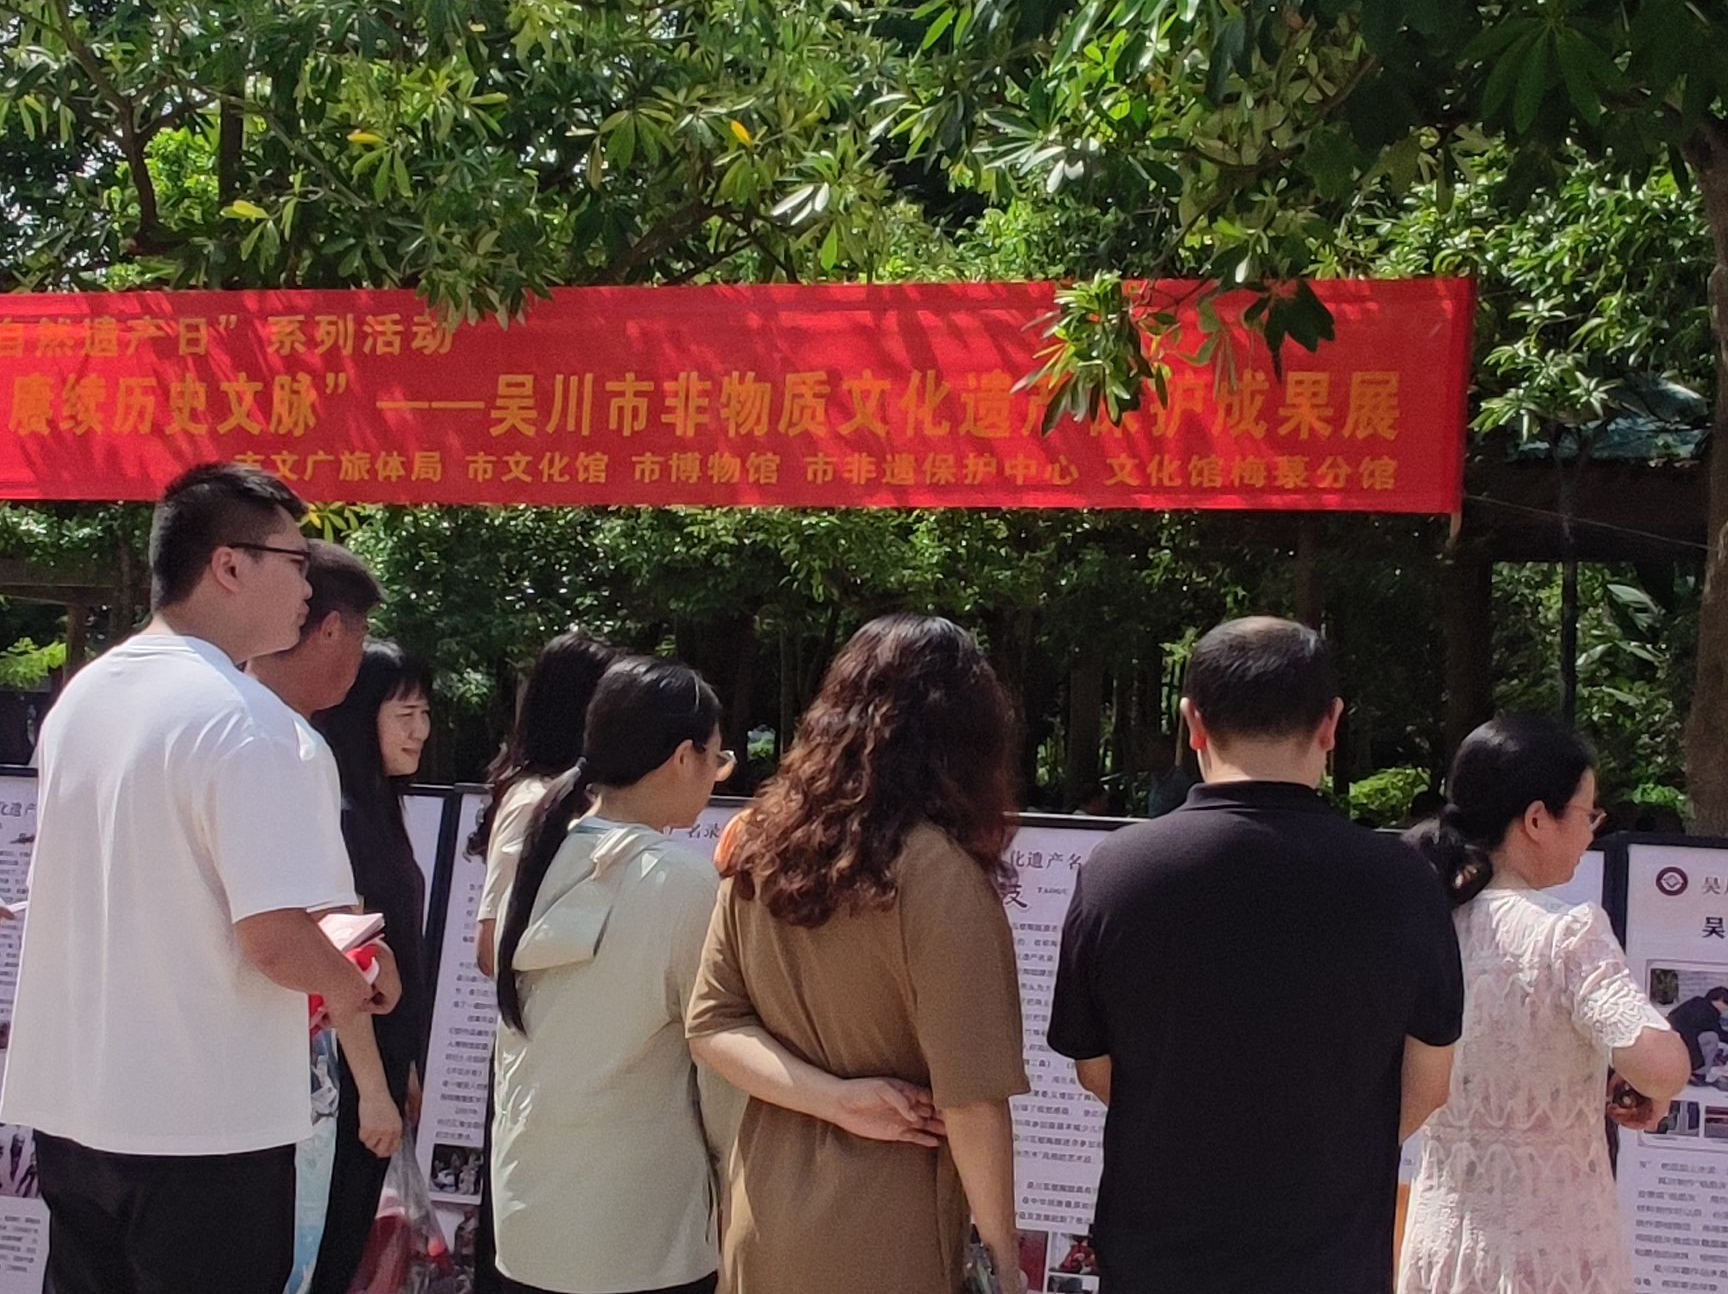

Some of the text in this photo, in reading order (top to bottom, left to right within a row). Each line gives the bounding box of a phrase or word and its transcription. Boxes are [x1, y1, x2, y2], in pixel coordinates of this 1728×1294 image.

[465, 451, 609, 485] 市文化馆
[631, 451, 781, 485] 市博物馆
[803, 452, 1080, 487] 市非遗保护中心
